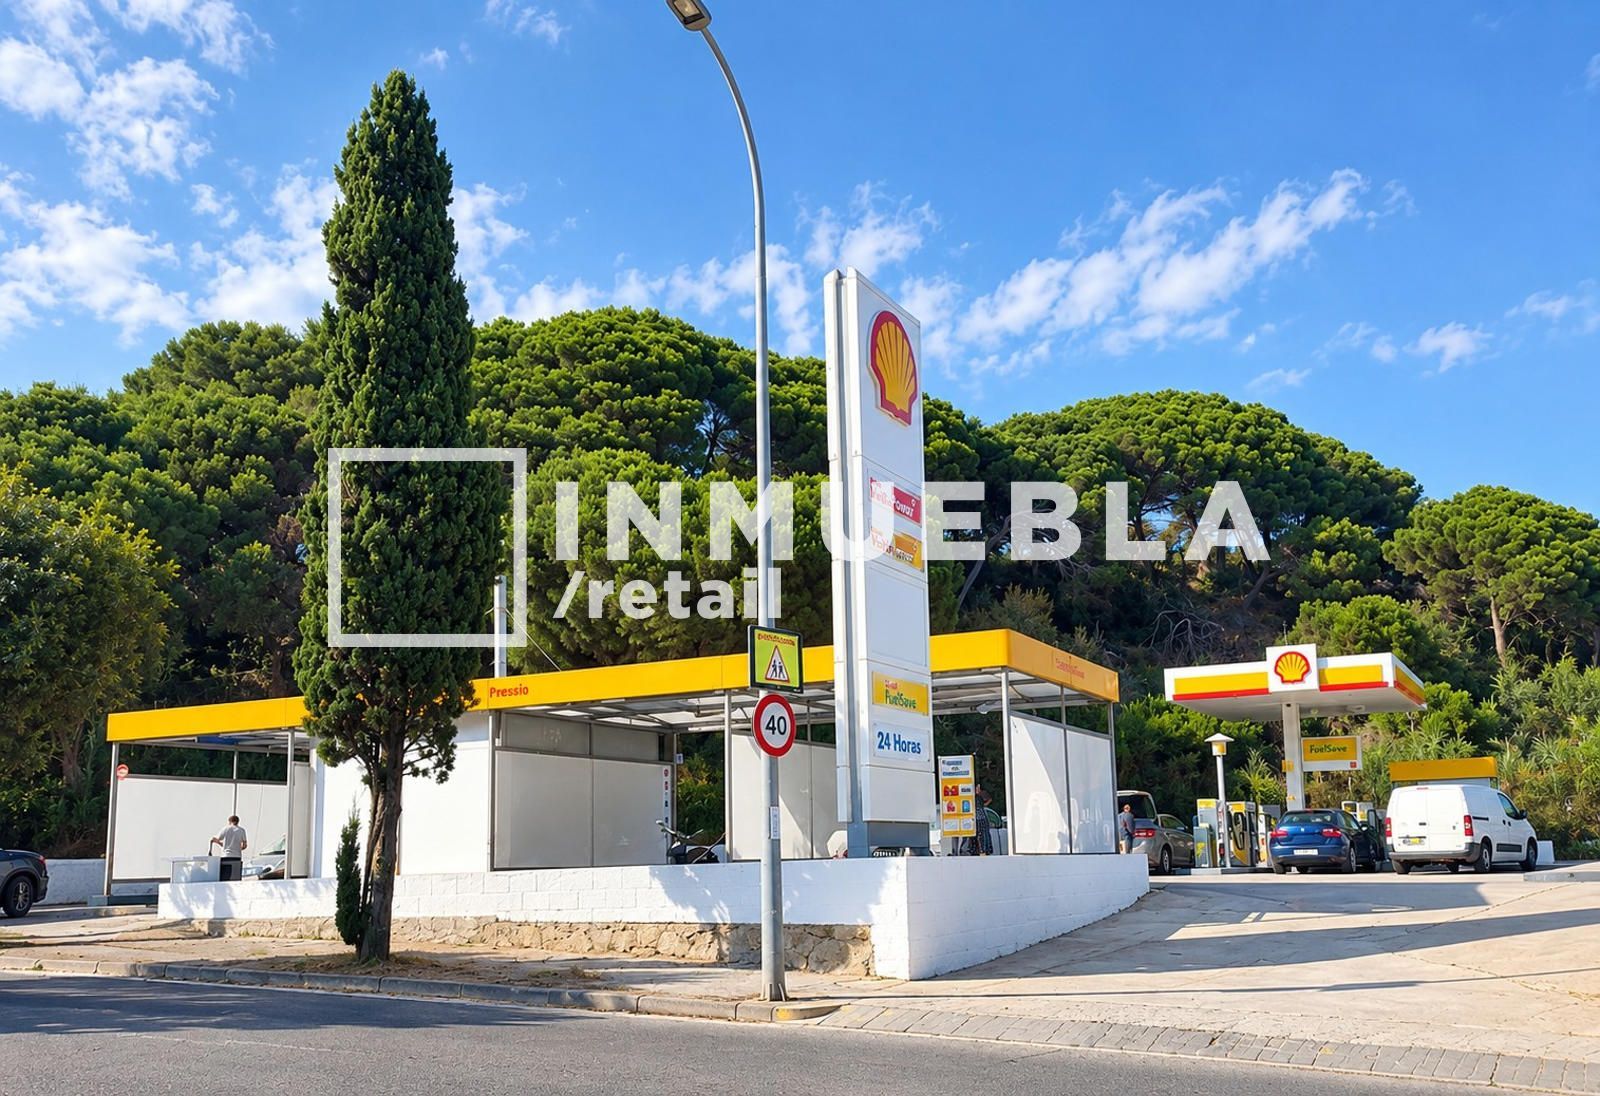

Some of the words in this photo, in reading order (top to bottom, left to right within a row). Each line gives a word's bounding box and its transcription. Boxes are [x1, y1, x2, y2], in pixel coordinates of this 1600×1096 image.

[489, 683, 529, 698] Pressio
[765, 714, 787, 736] 40
[877, 731, 891, 750] 24
[893, 733, 921, 754] Horas
